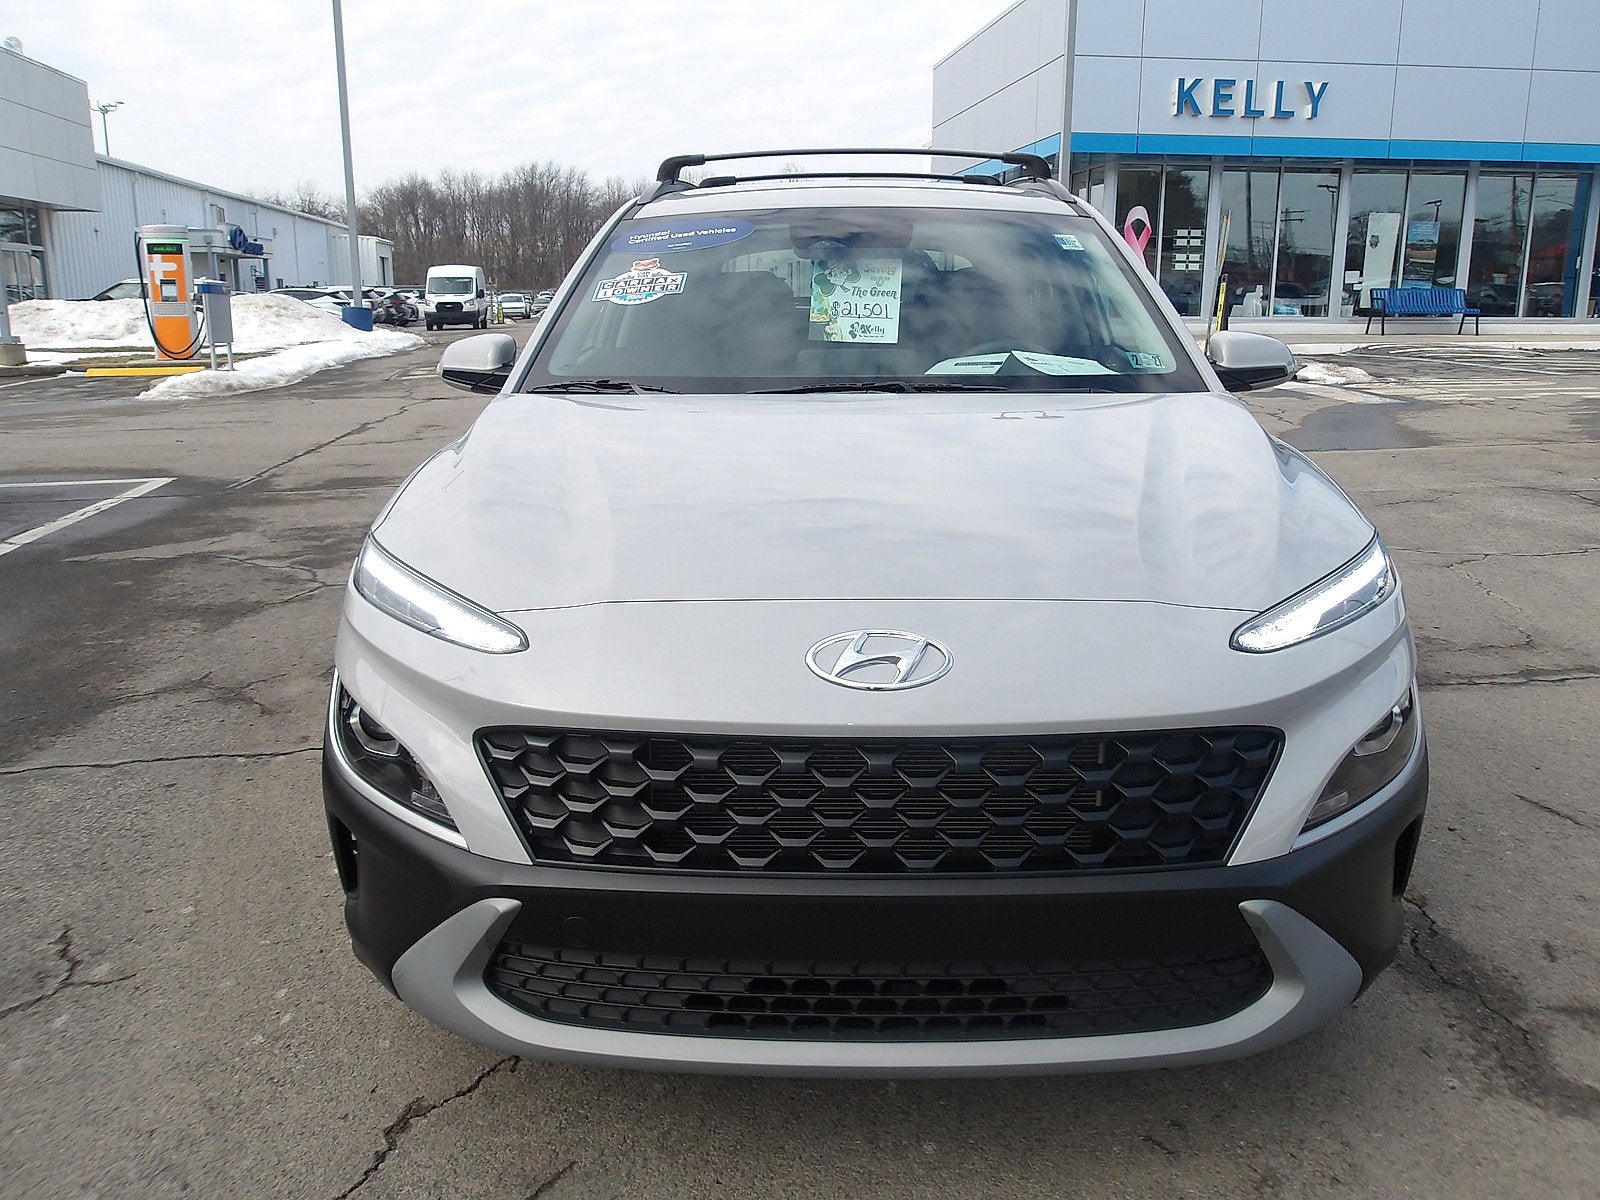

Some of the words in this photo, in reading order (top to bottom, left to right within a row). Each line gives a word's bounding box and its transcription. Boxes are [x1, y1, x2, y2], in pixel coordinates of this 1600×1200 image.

[1173, 77, 1330, 120] KELLY
[628, 235, 669, 245] Certified
[671, 230, 695, 239] Used
[696, 227, 737, 236] Vehicles
[629, 230, 671, 241] Hyundai
[863, 264, 897, 276] Saving
[602, 277, 679, 289] CARFAX
[612, 283, 680, 295] OWNER
[850, 286, 868, 298] The
[869, 287, 898, 299] Green
[865, 324, 885, 334] Kelly
